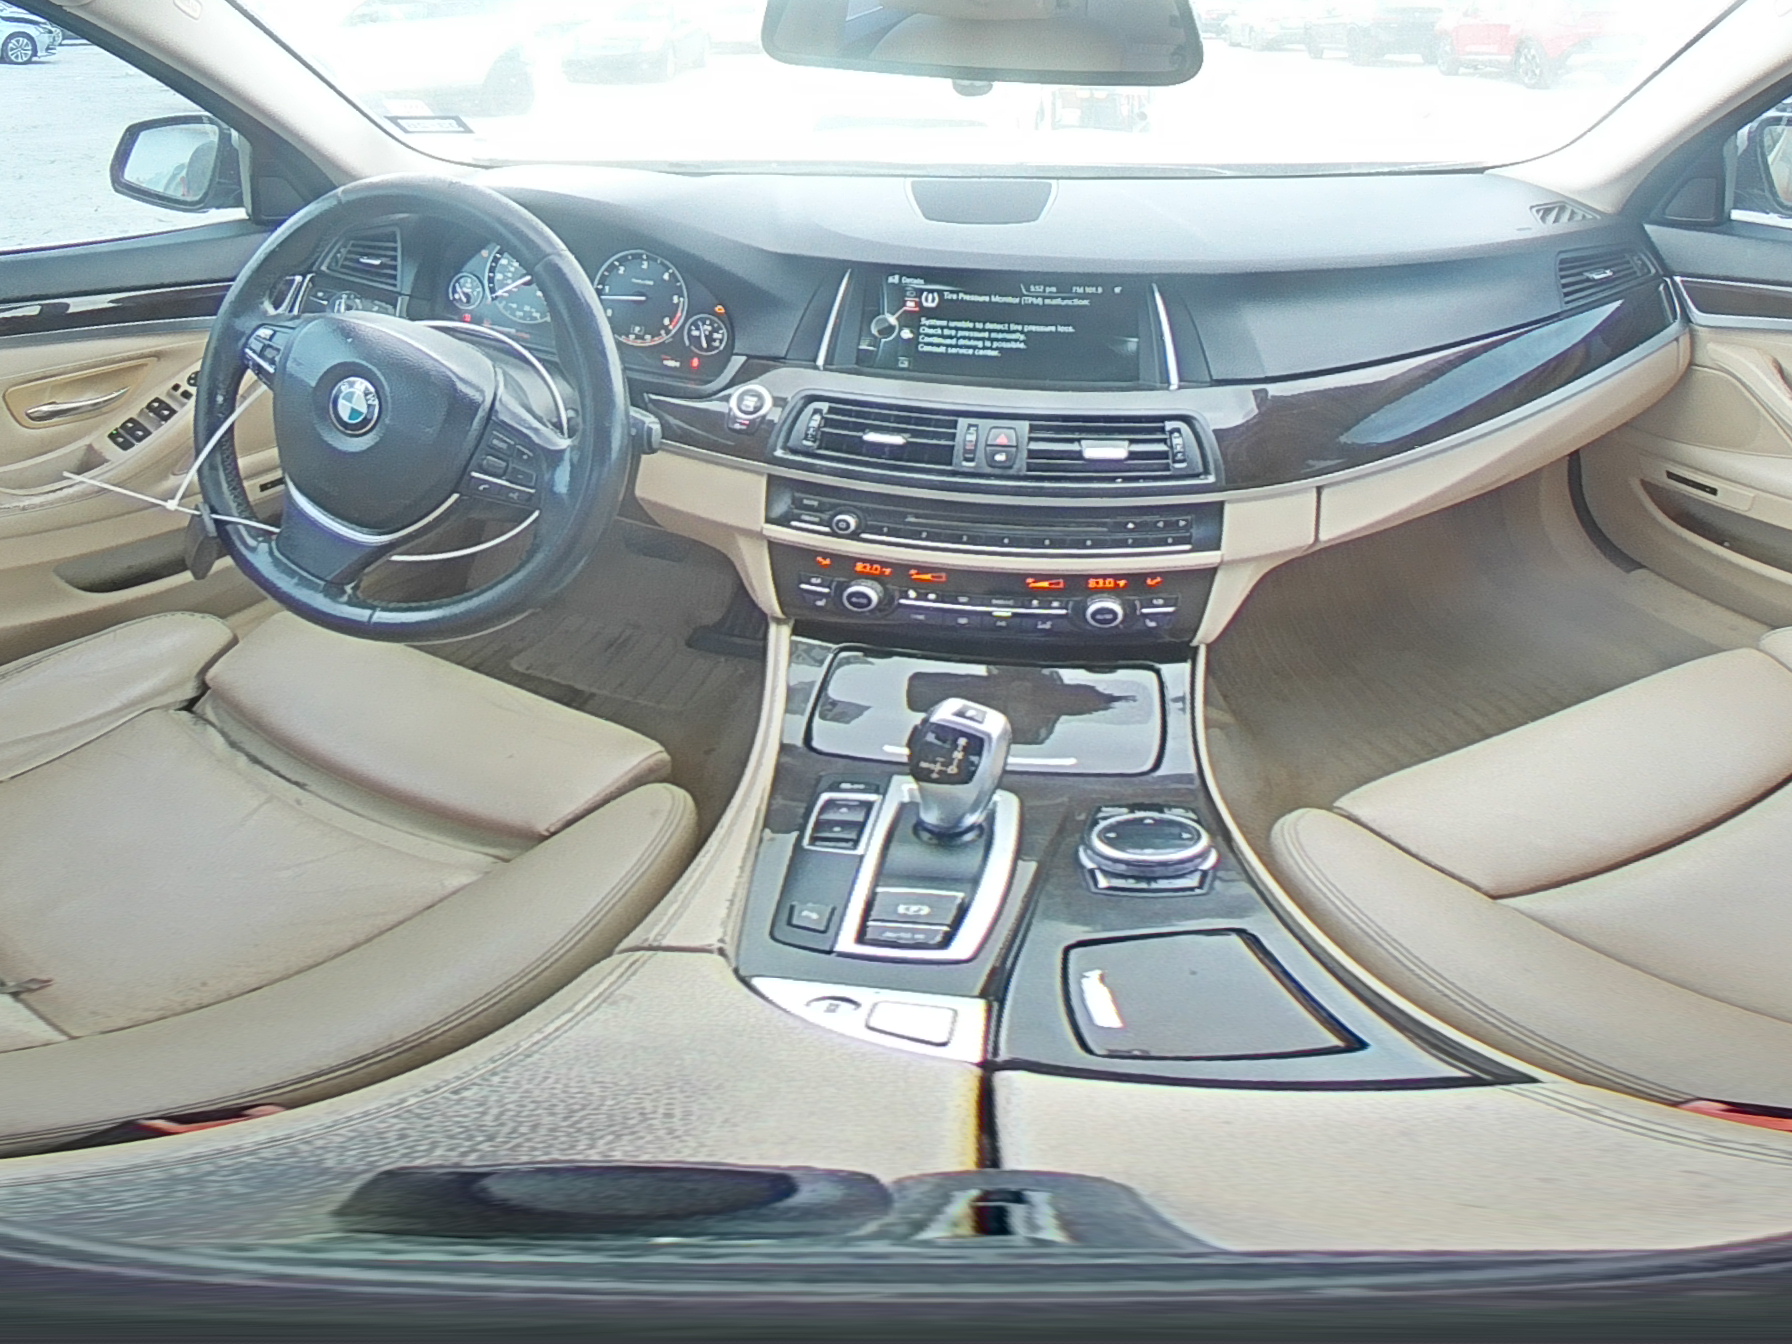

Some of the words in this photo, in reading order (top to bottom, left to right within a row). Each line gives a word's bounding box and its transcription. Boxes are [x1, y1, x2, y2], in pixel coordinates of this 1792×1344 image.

[618, 266, 625, 274] 2
[943, 291, 957, 300] Tire
[959, 293, 989, 302] Pressure
[991, 295, 1020, 304] Monitor
[1021, 297, 1043, 306] (TPM)
[920, 317, 947, 326] System
[948, 320, 974, 328] unable
[984, 322, 1008, 330] detect
[1010, 323, 1022, 331] tire
[1023, 324, 1056, 332] pressure
[919, 326, 942, 335] Check
[943, 328, 956, 336] tire
[957, 330, 989, 338] pressure
[919, 335, 957, 345] Continued
[958, 338, 983, 348] driving
[918, 343, 946, 354] Consult
[947, 347, 974, 355] service
[975, 349, 1001, 357] center.
